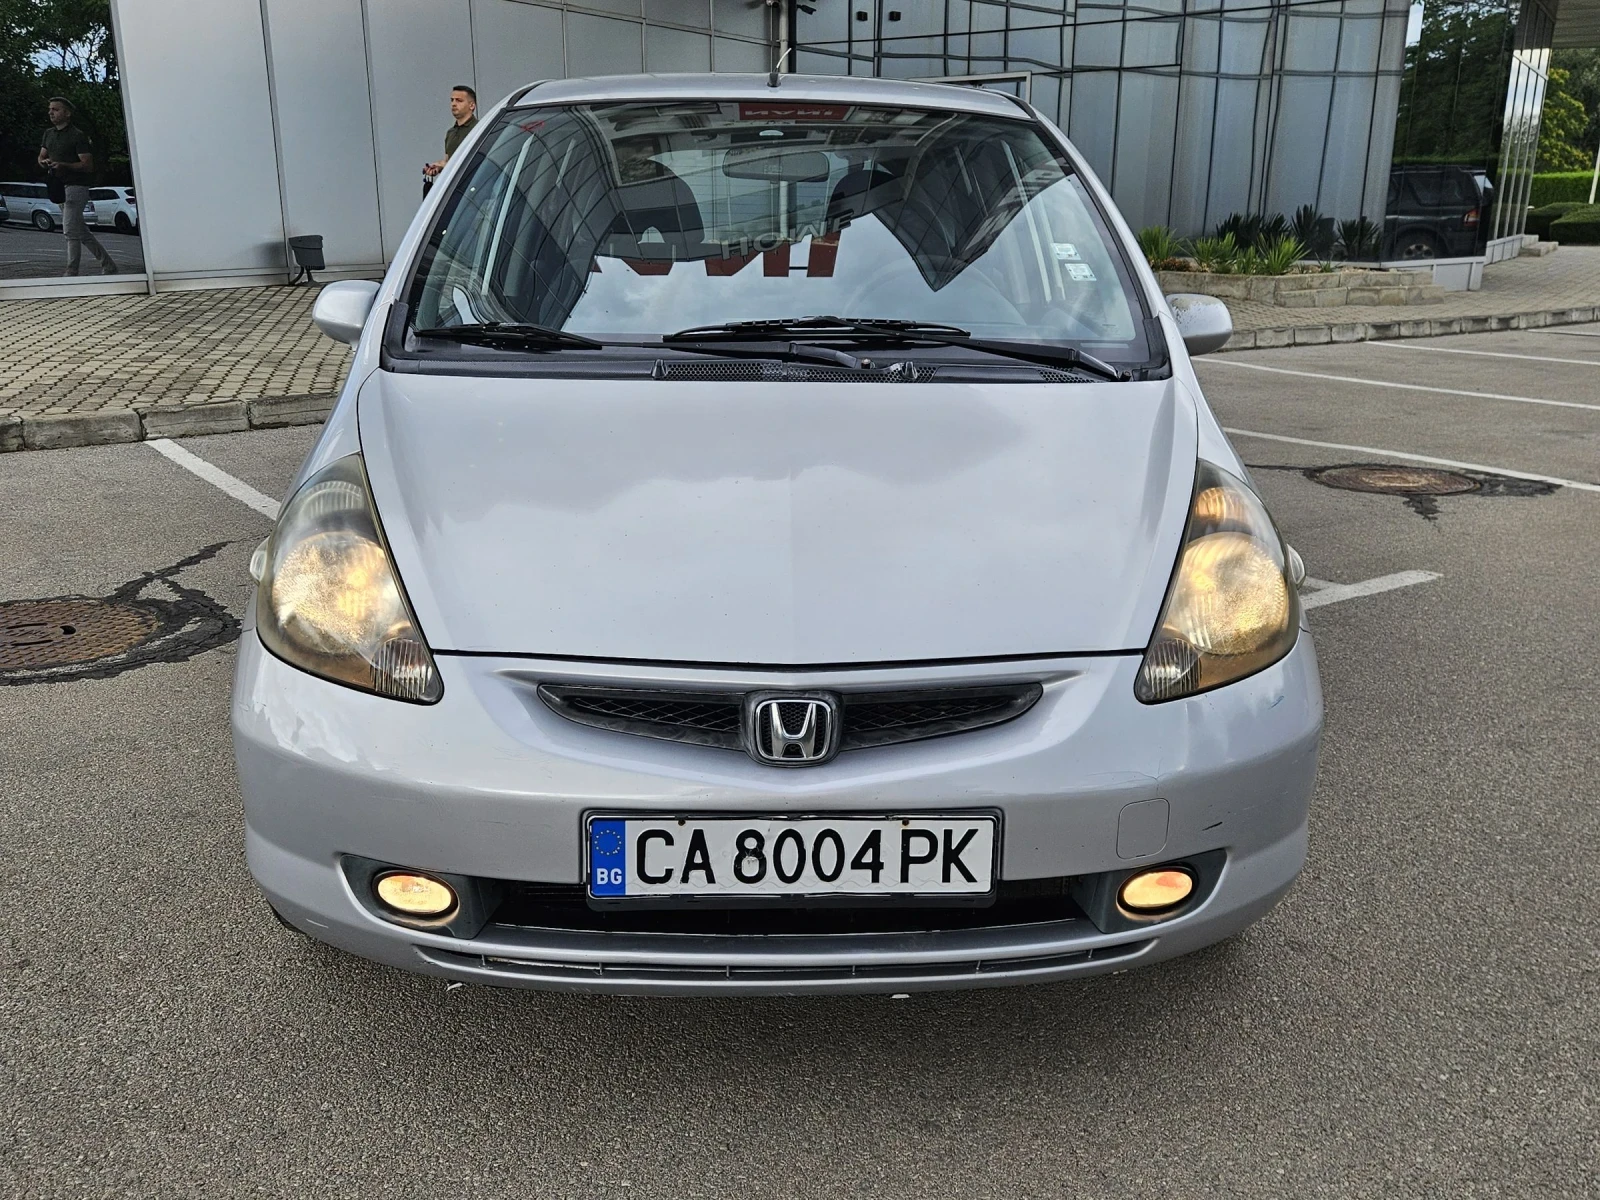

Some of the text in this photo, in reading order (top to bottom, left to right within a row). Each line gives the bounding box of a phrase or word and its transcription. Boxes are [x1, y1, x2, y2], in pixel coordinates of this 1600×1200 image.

[635, 828, 979, 885] CA 8004 PK
[596, 868, 623, 885] BG
